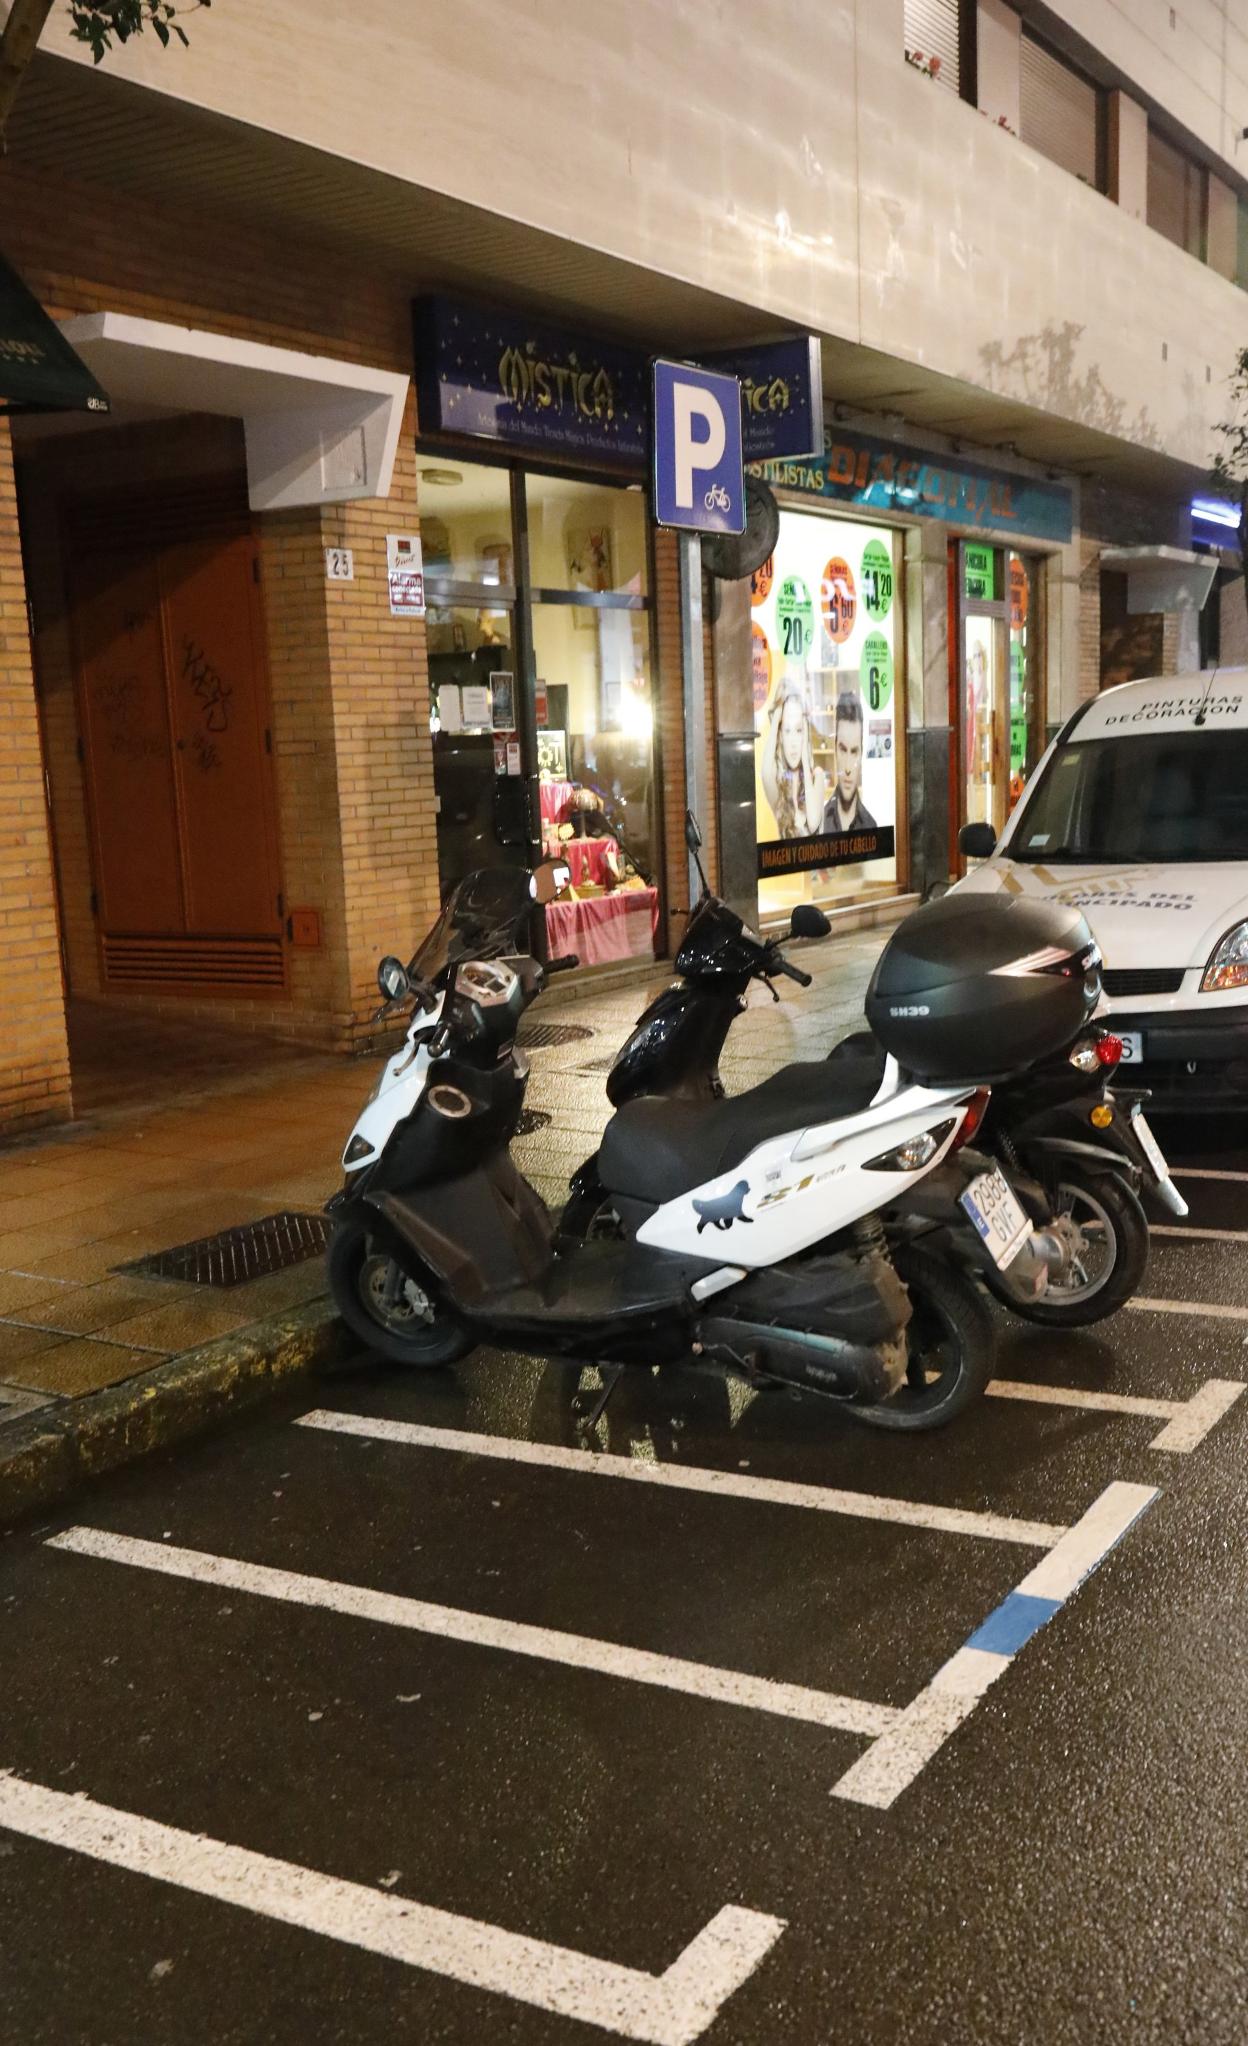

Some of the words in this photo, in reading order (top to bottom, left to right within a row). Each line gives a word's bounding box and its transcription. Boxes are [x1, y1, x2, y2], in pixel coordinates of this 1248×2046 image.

[674, 382, 726, 509] P
[333, 552, 349, 576] 25
[783, 617, 802, 655] 20
[869, 666, 880, 710] 6
[1141, 696, 1243, 711] PINTURAS
[762, 846, 791, 868] IMAGEN
[849, 836, 877, 855] CABELLO
